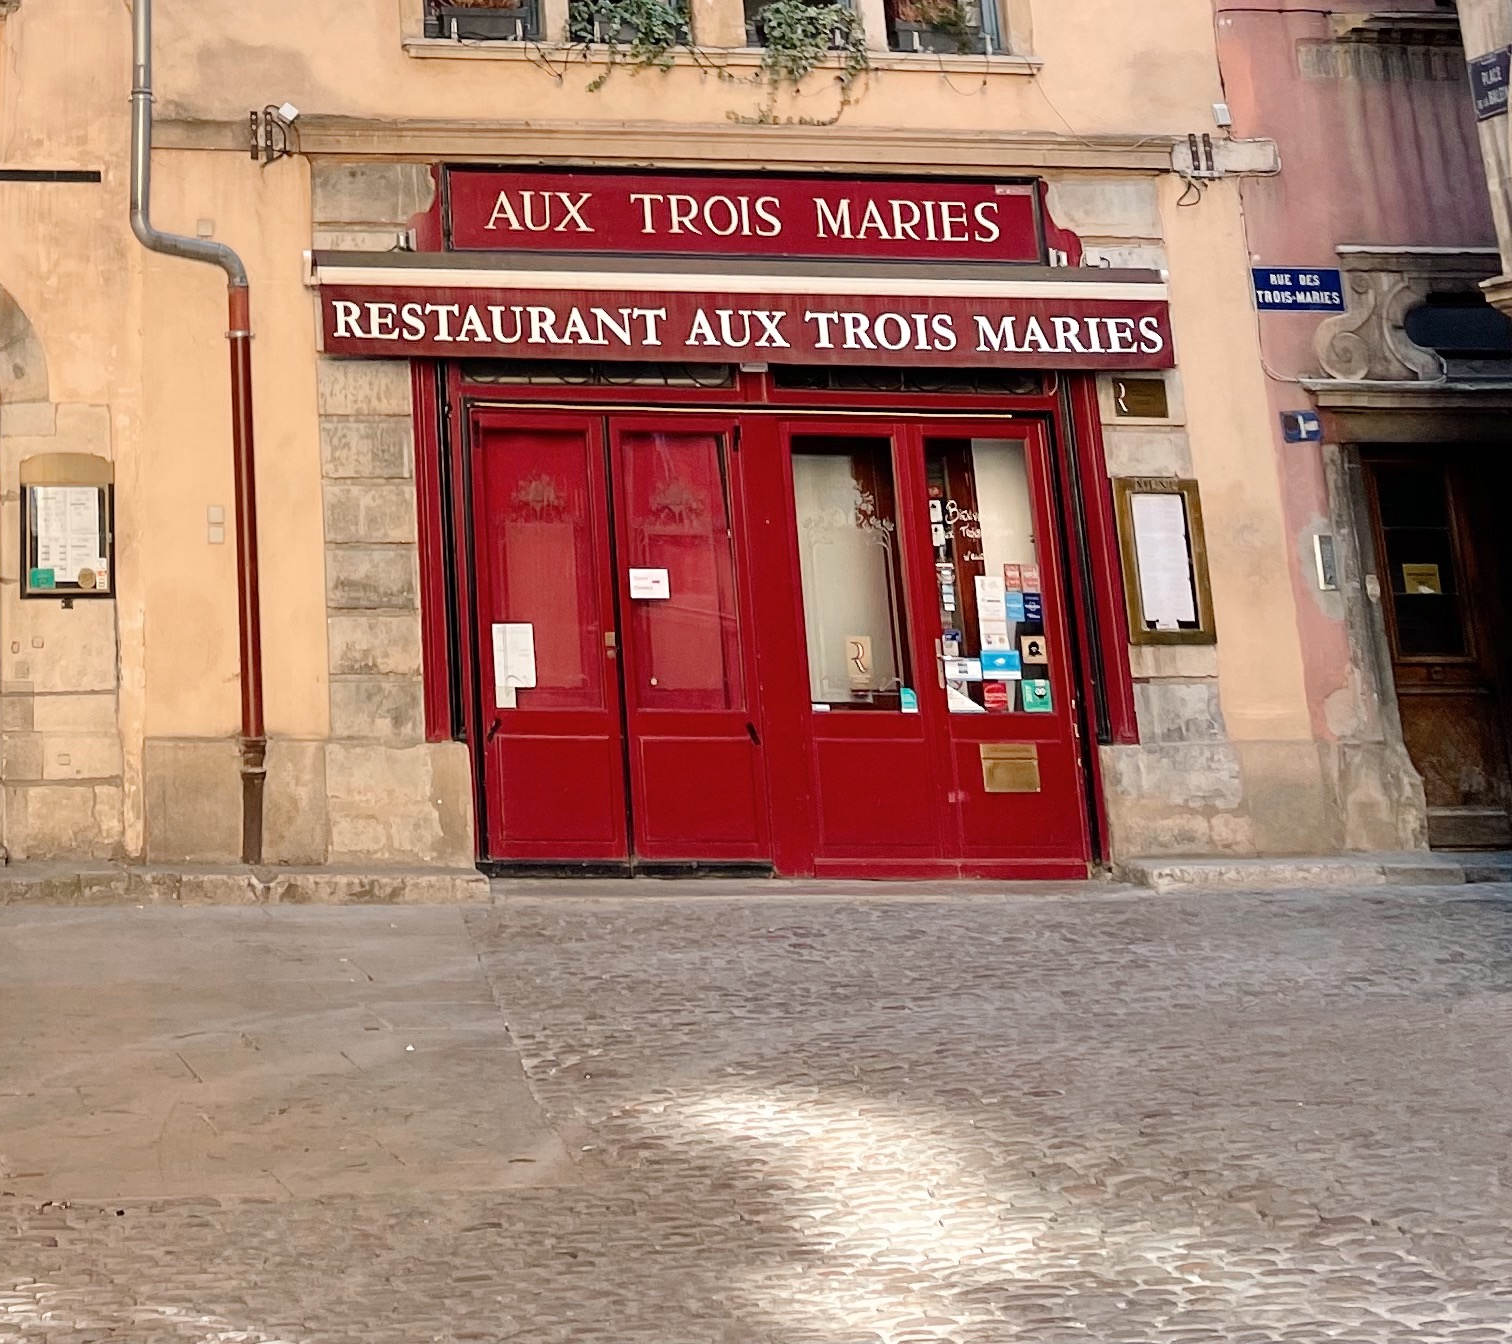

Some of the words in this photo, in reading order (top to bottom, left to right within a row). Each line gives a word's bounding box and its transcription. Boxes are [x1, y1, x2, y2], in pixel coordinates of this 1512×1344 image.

[483, 189, 596, 233] AUX
[629, 192, 783, 238] TROIS
[812, 196, 1001, 243] MARIES
[1269, 273, 1293, 286] RUE
[1298, 274, 1320, 286] DES
[1256, 290, 1341, 305] TROIS-MARIES
[330, 299, 669, 348] RESTAURANT
[684, 307, 792, 350] AUX
[804, 309, 958, 353] TROIS
[974, 314, 1164, 355] MARIES
